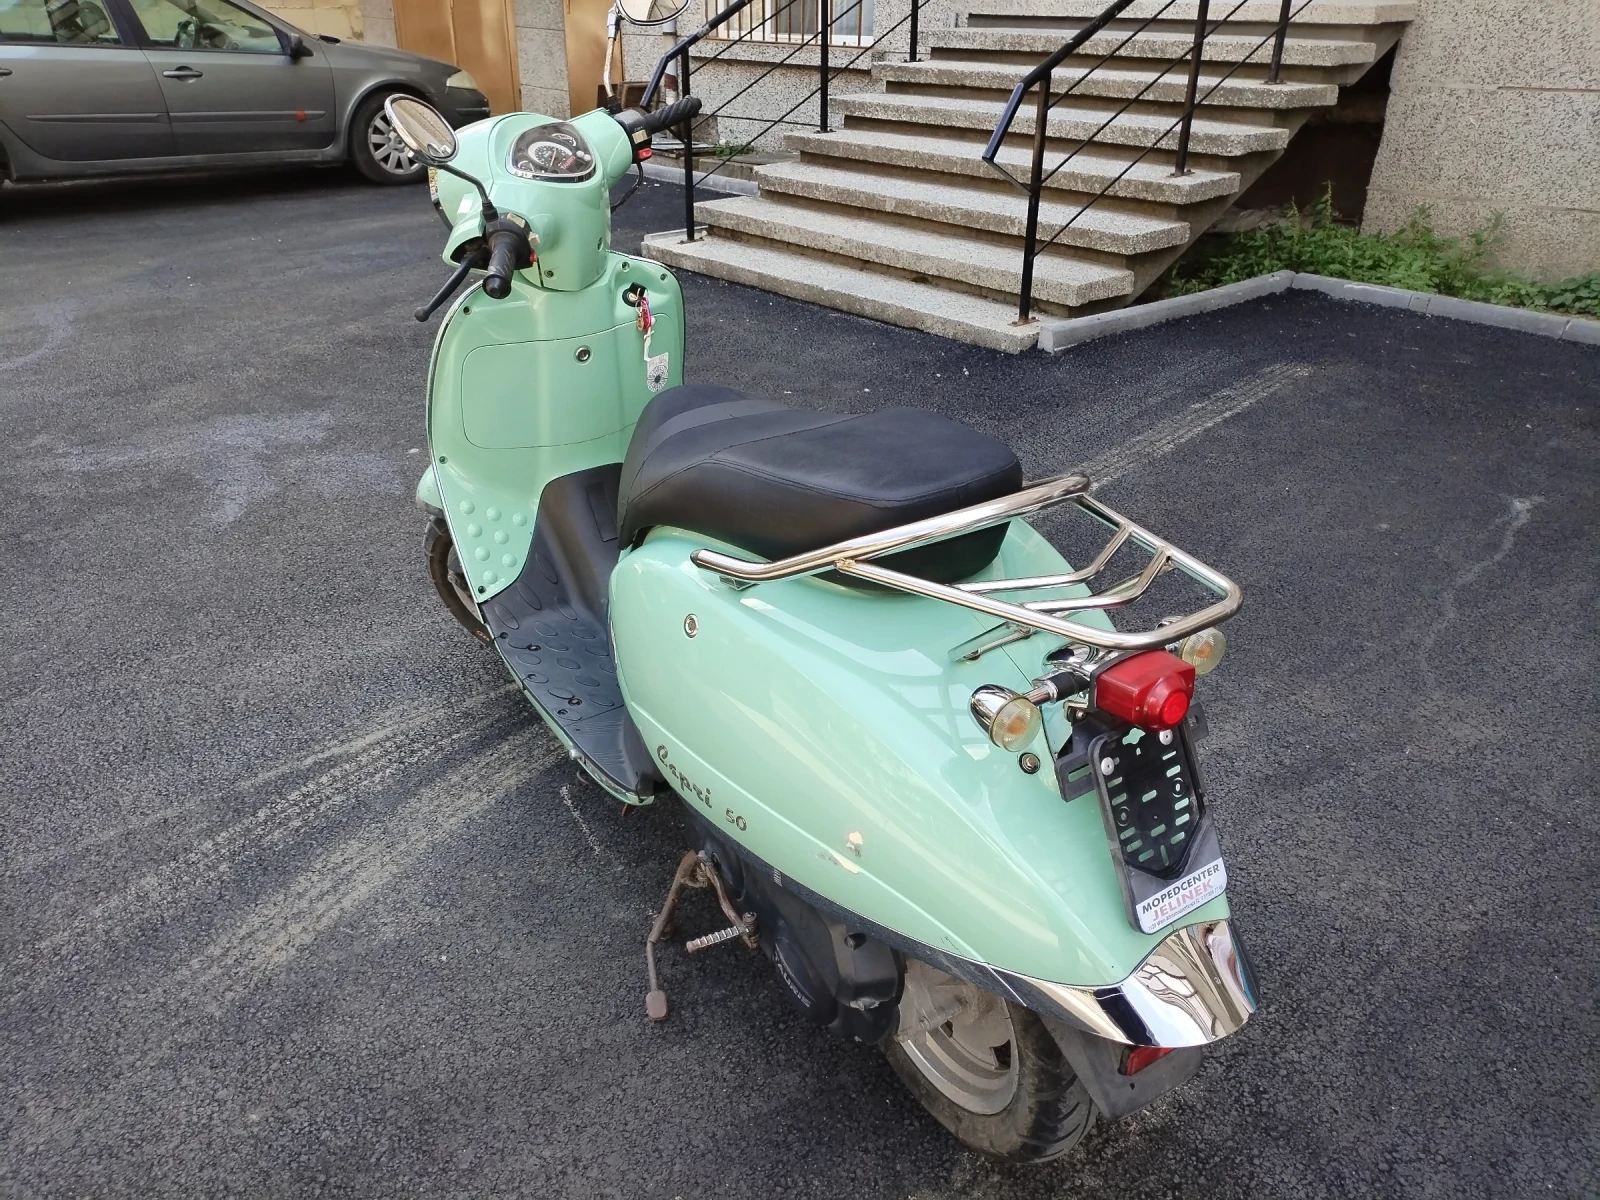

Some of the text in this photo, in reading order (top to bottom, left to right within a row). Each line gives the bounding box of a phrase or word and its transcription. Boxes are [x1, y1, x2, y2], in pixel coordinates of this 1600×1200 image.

[656, 744, 747, 831] Capri 50
[1142, 863, 1220, 914] MOPEDCENTER
[1152, 879, 1214, 922] JELINEK
